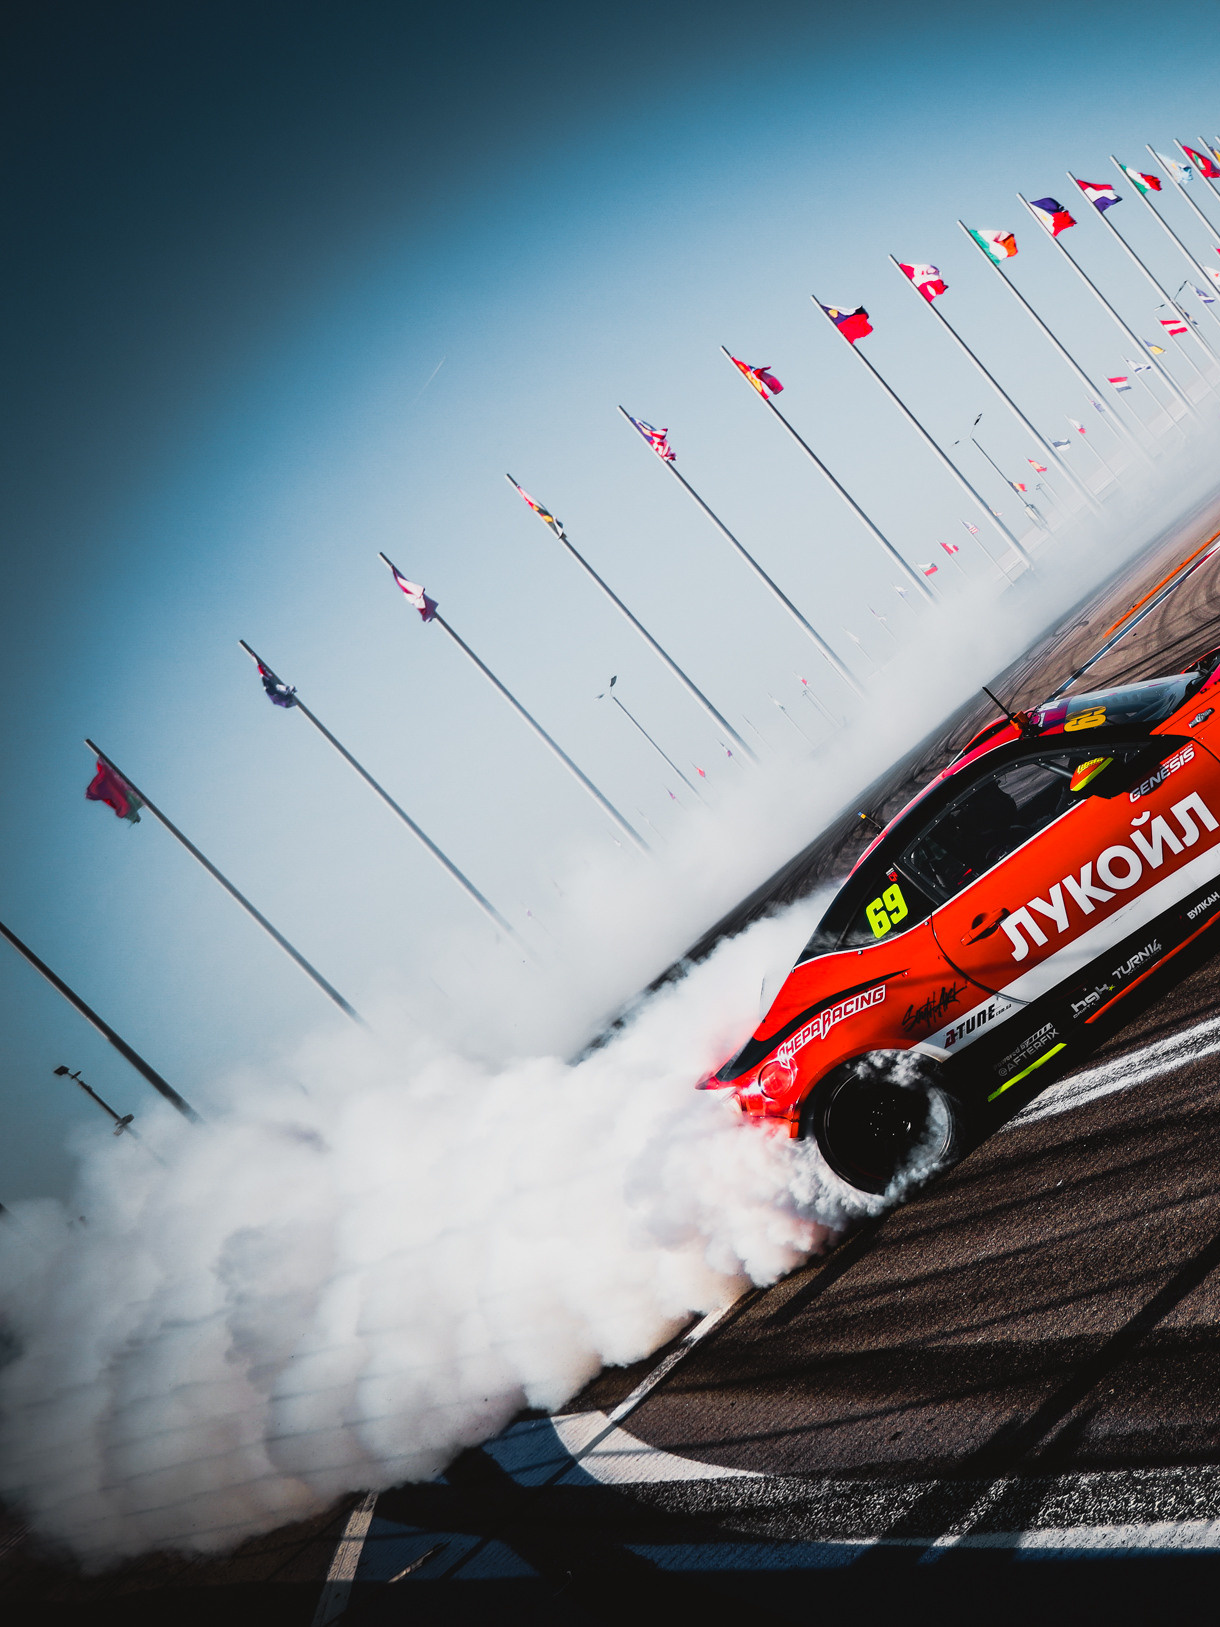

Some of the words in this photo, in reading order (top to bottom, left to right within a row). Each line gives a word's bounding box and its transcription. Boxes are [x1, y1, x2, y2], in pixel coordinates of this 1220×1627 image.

[1129, 748, 1195, 803] GENESIS
[1000, 791, 1220, 962] ЛУКОЙЛ
[865, 883, 909, 939] 69
[1186, 891, 1220, 920] ВУЛКАН
[1112, 938, 1163, 980] TURN14
[998, 1028, 1060, 1077] @AFTERFIX
